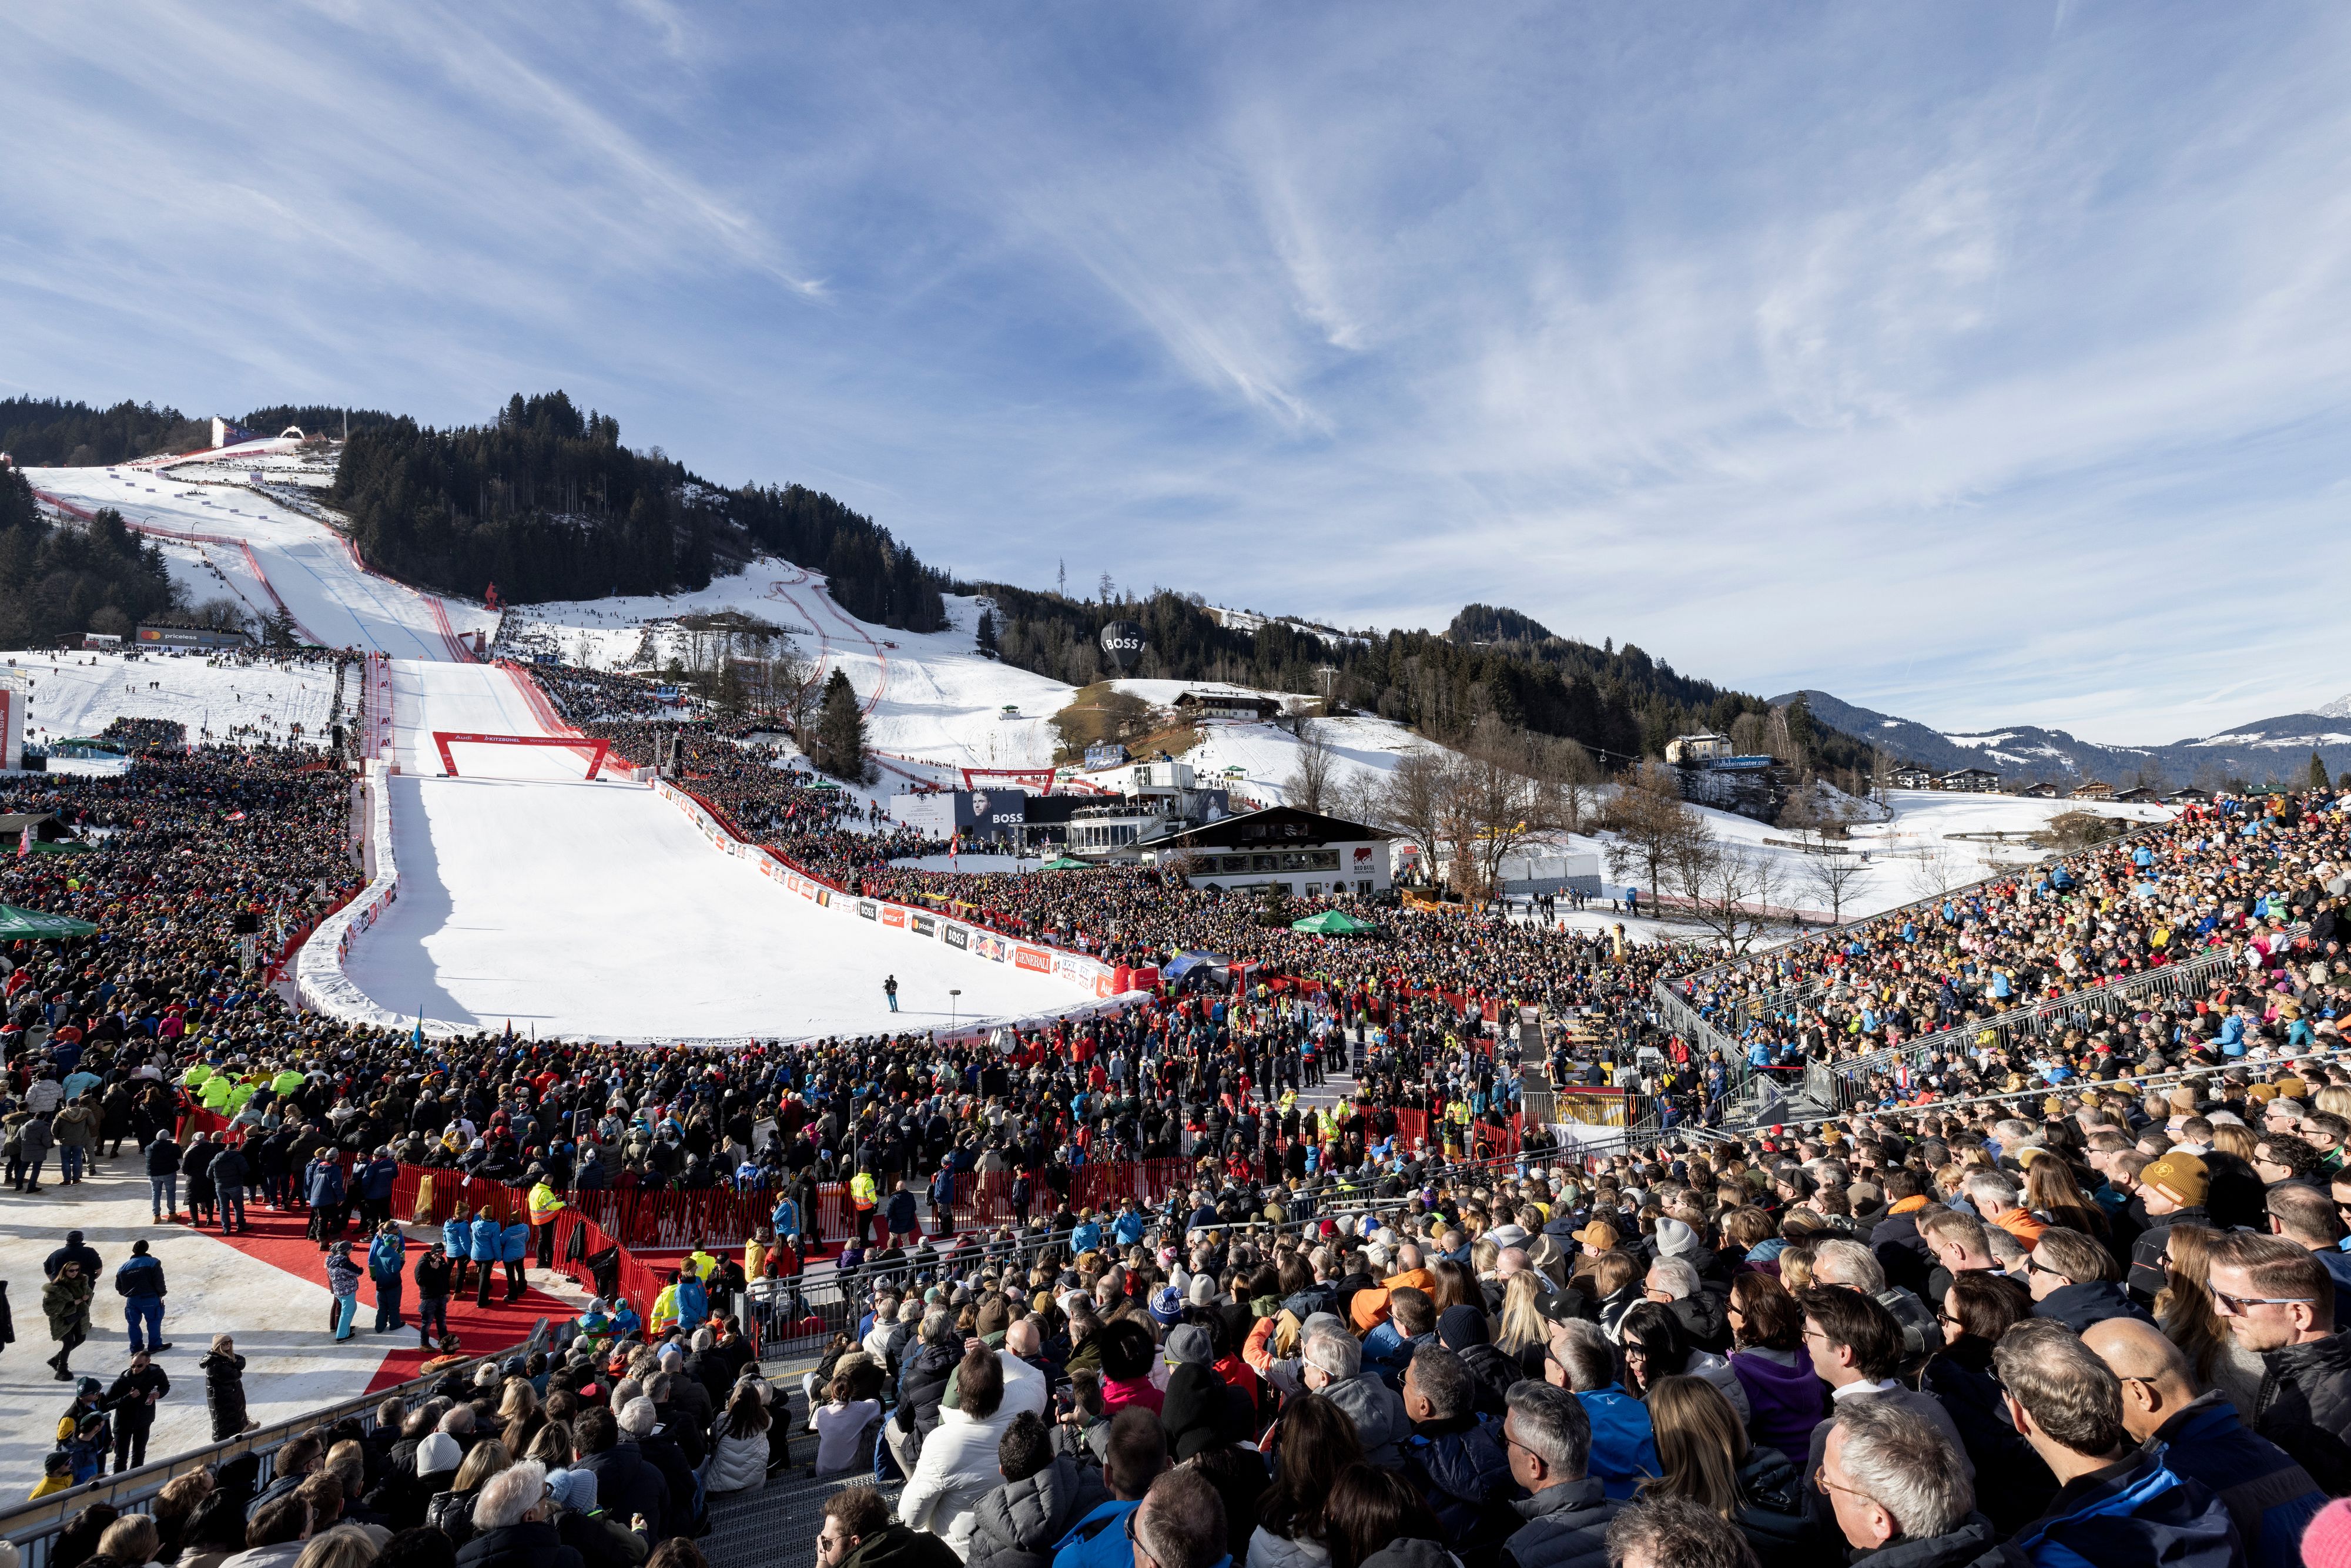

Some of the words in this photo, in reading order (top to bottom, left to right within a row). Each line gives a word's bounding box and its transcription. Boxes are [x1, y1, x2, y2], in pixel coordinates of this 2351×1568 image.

[1106, 638, 1138, 649] BOSS
[1714, 759, 1769, 768] Hallsteinwater.com
[993, 813, 1023, 823] BOSS
[861, 904, 874, 917] BOSS
[883, 913, 898, 923] Austrian
[919, 922, 935, 933] priceless
[948, 929, 964, 946] BOSS
[1007, 949, 1014, 961] A1
[1016, 951, 1050, 970] GENERALI
[1052, 960, 1060, 973] A1
[1063, 959, 1077, 971] LIQUI
[1062, 969, 1076, 982] MOLY
[1165, 1300, 1178, 1312] NEW
